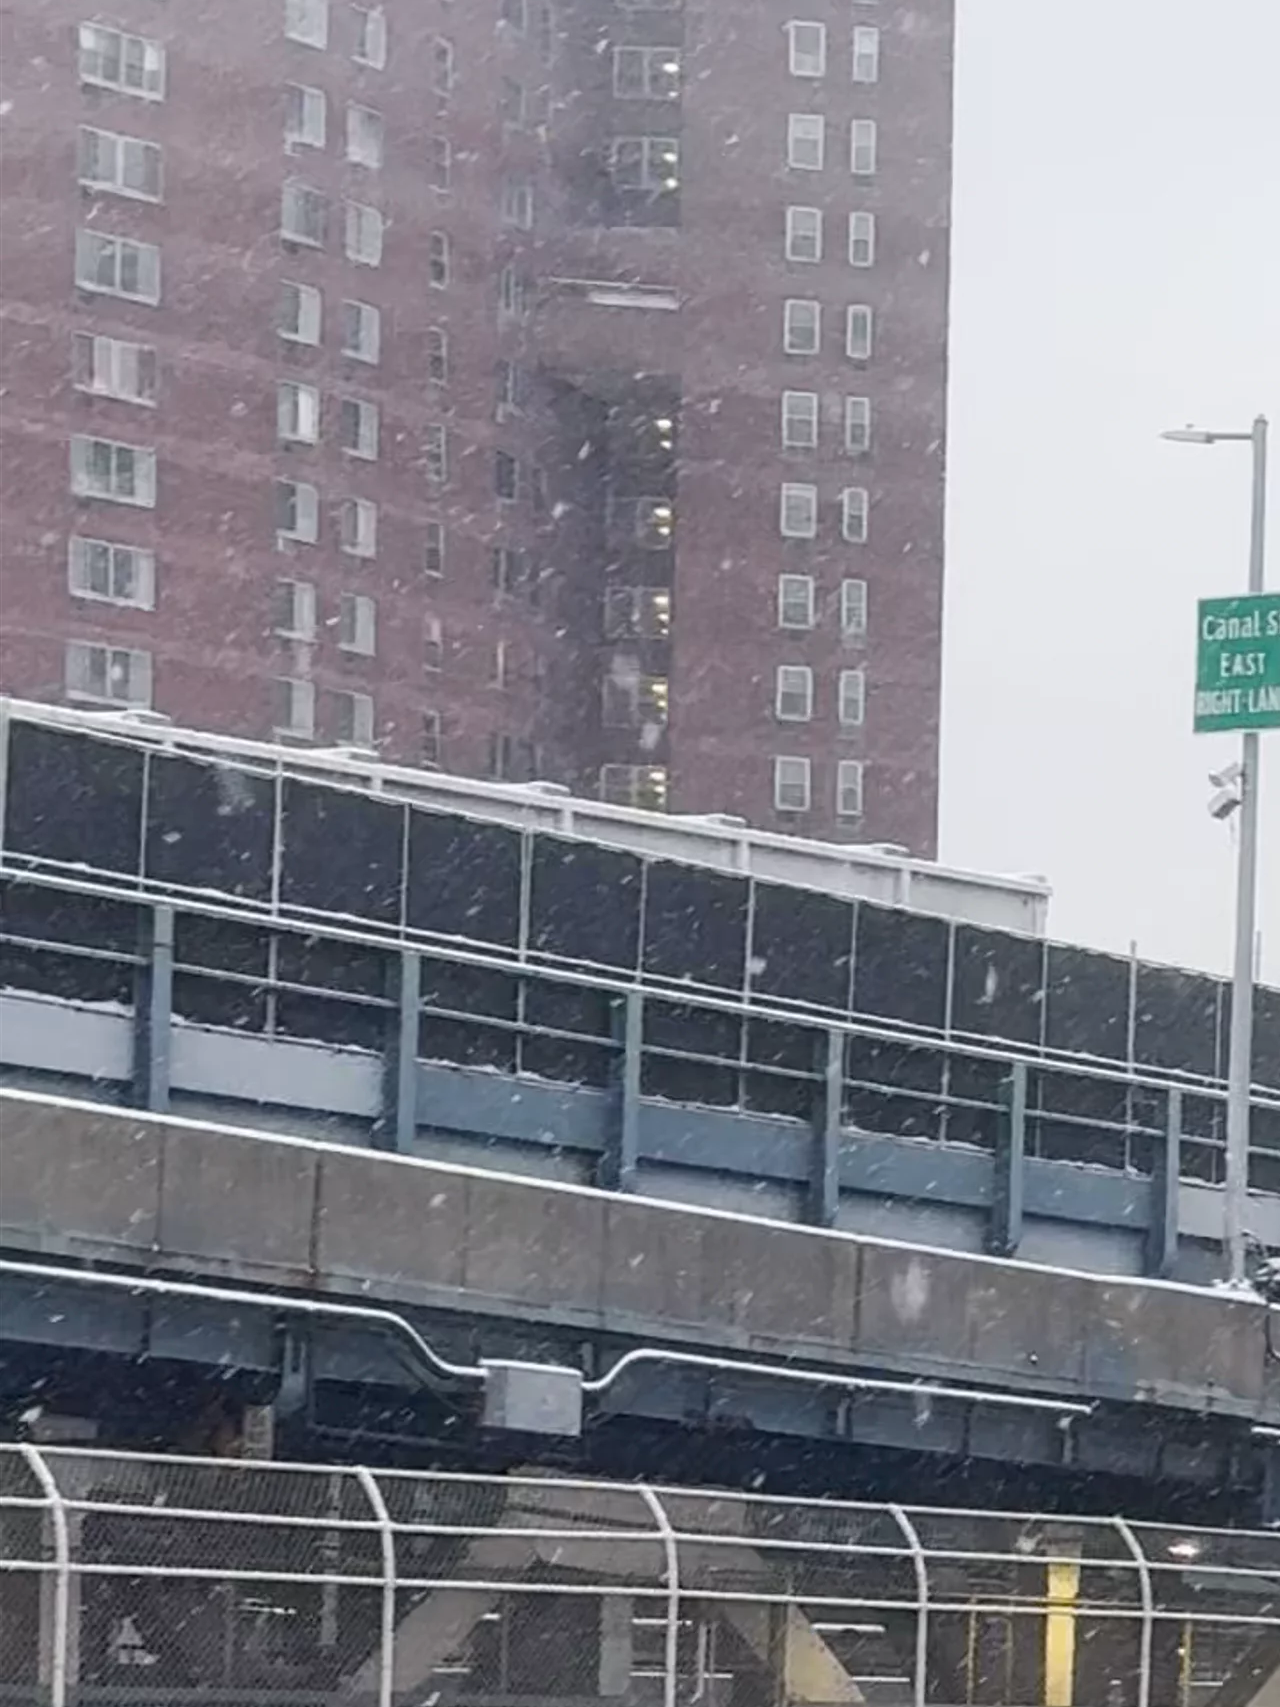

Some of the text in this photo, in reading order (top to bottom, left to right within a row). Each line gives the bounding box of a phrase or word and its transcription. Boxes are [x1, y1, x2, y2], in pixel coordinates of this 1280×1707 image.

[1202, 610, 1260, 641] Canal
[1220, 653, 1265, 677] EAST
[1196, 689, 1241, 716] RIGHT
